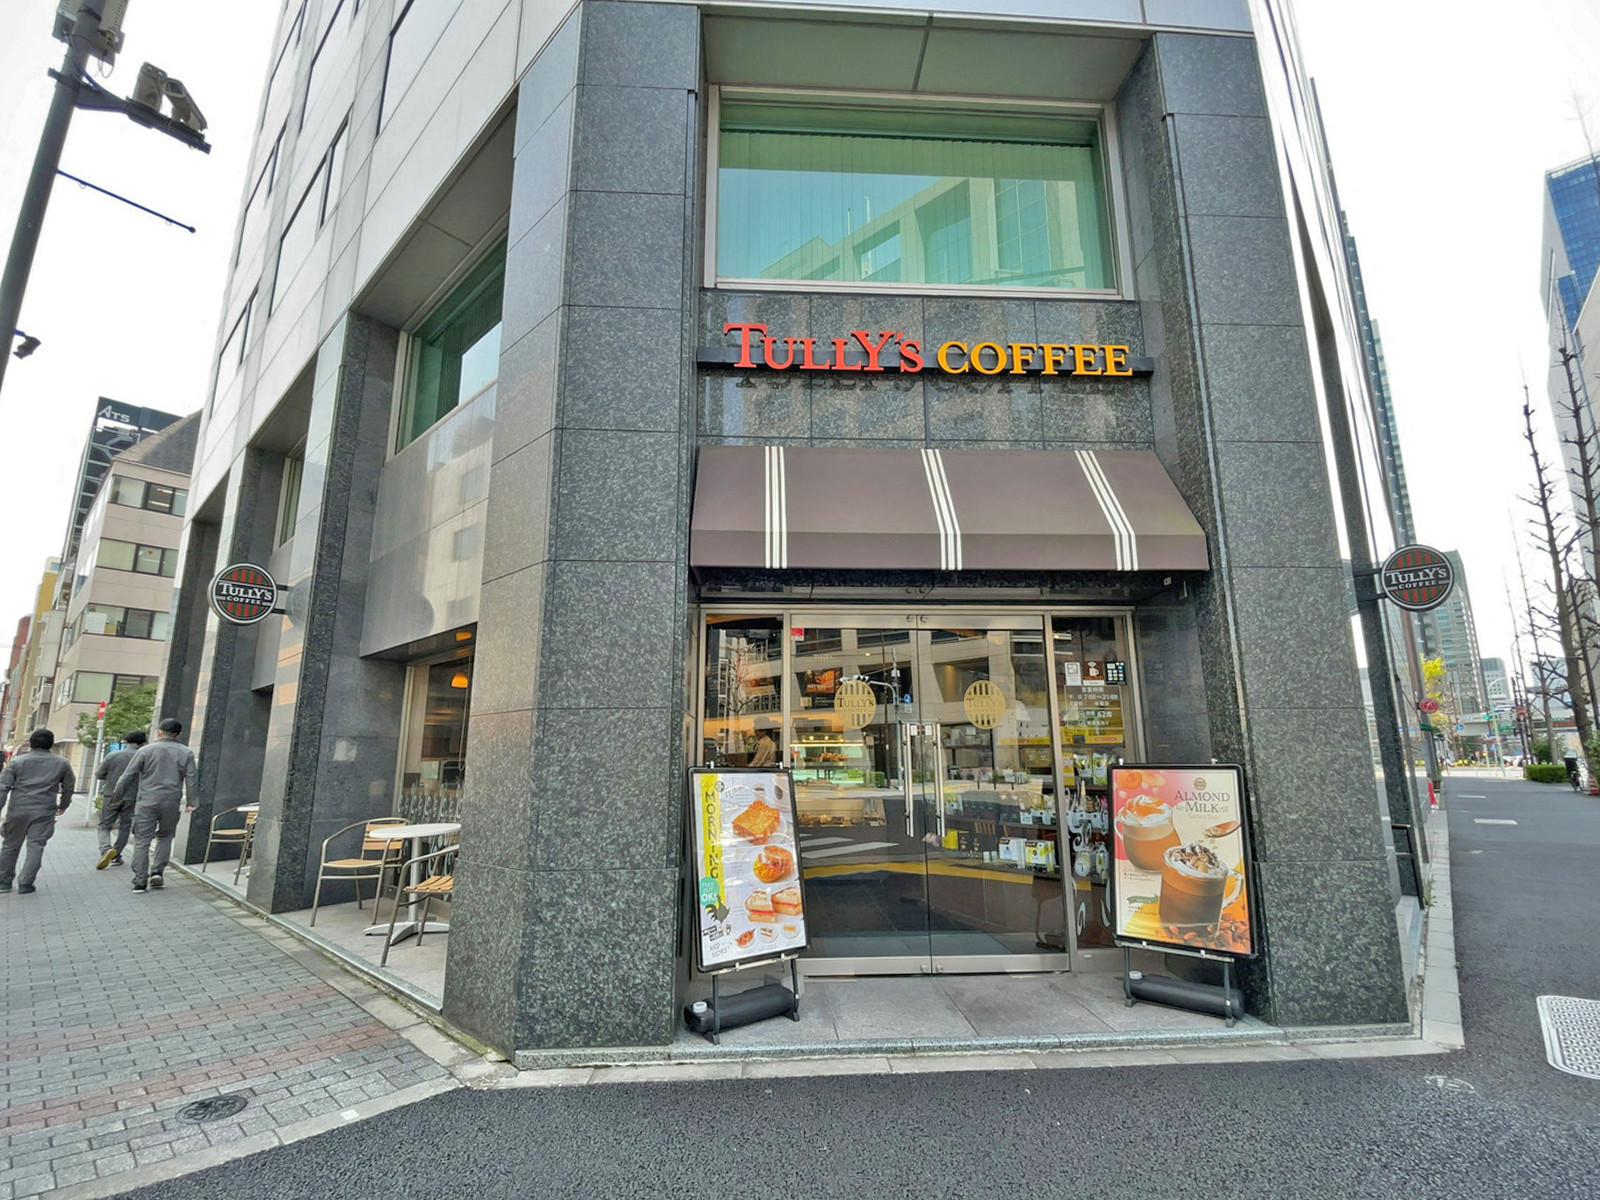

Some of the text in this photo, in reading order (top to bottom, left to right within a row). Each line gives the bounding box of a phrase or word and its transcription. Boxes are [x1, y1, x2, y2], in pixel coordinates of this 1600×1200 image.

[723, 322, 1134, 376] TULLY'S COFFEE
[98, 405, 130, 423] ATS
[1386, 567, 1447, 585] TULLY'S
[1399, 580, 1437, 590] COFFEE
[219, 582, 272, 601] TULLY'S
[226, 595, 262, 605] COFFEE
[1174, 790, 1231, 802] ALMOND
[1185, 802, 1219, 813] MILK
[705, 791, 719, 879] MORNING
